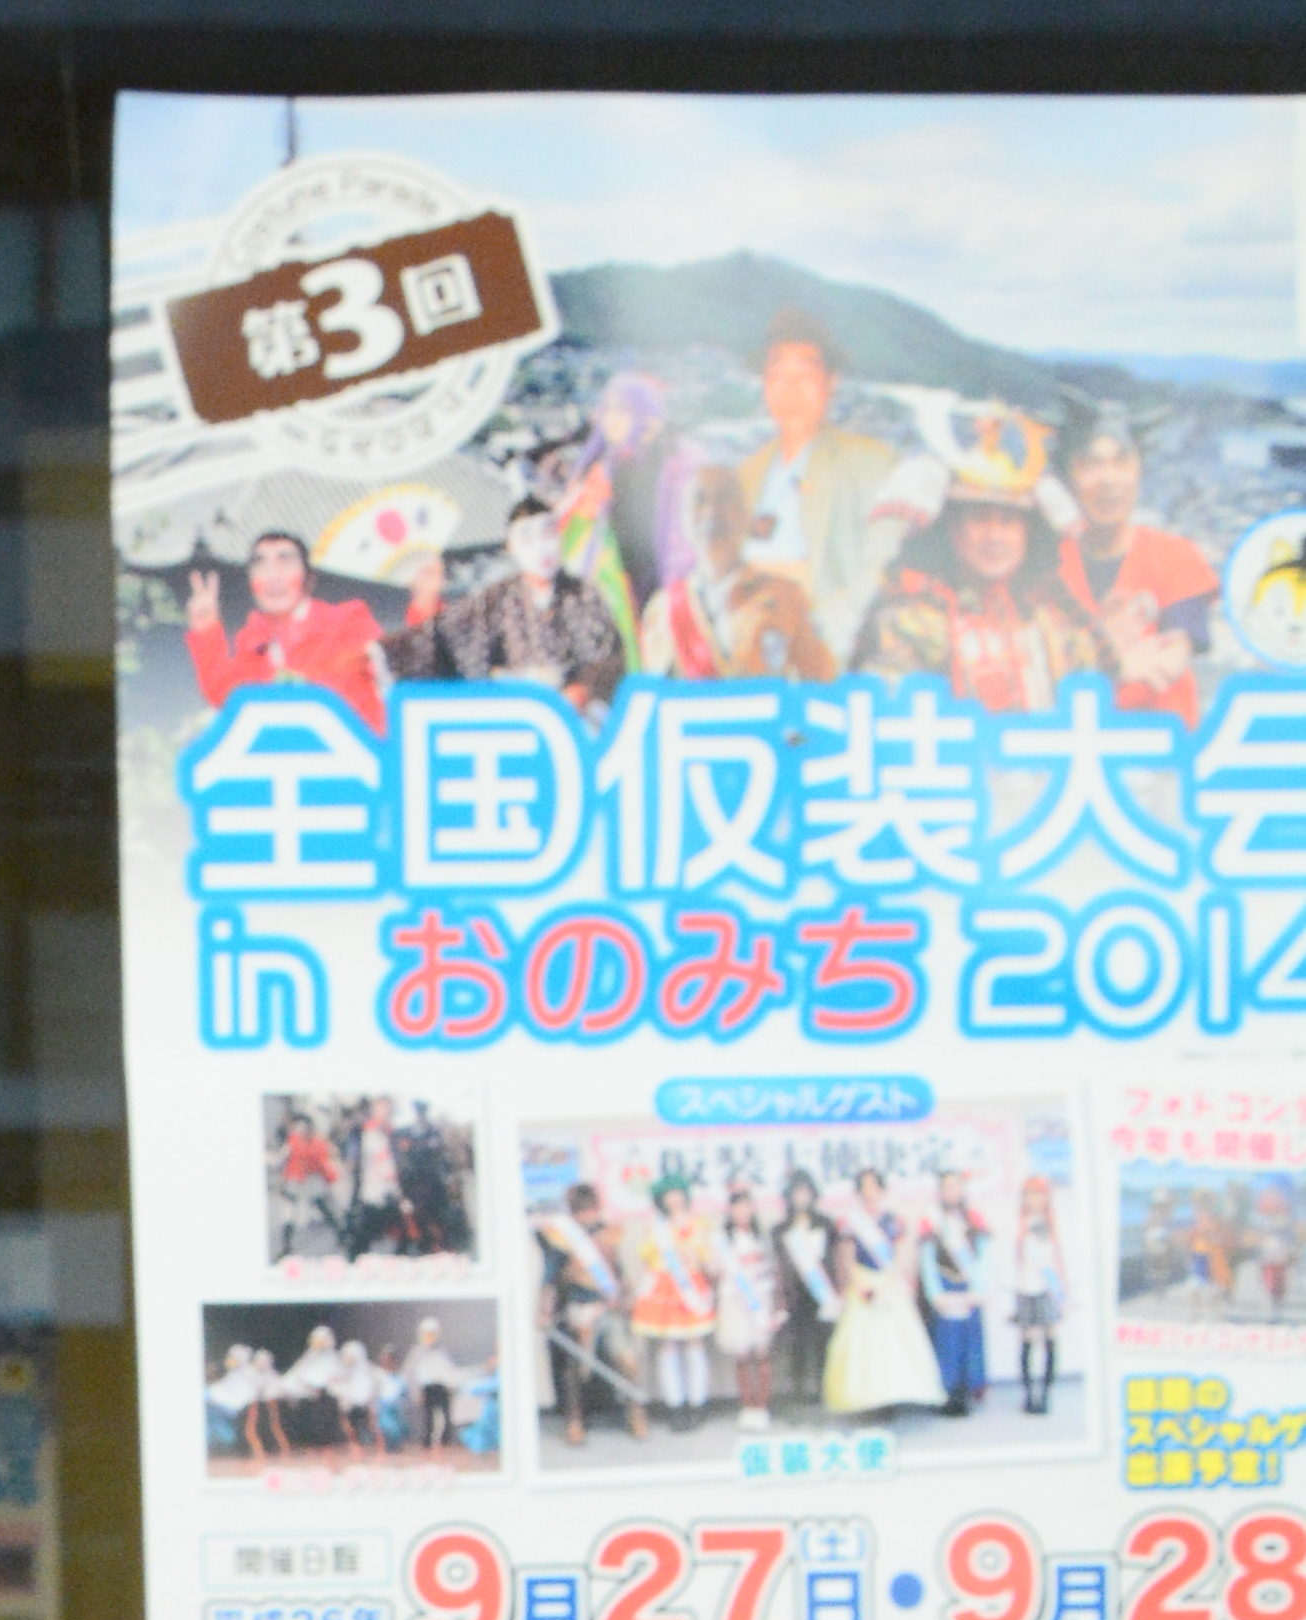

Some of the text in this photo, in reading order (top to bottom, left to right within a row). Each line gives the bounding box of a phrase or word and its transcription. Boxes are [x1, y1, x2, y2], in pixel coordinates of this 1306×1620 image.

[240, 255, 486, 382] 第3回
[186, 685, 1306, 895] 全国仮装大会
[208, 912, 318, 1040] in
[386, 905, 920, 1040] おのみち
[674, 1079, 922, 1121] スペシャルゲスト
